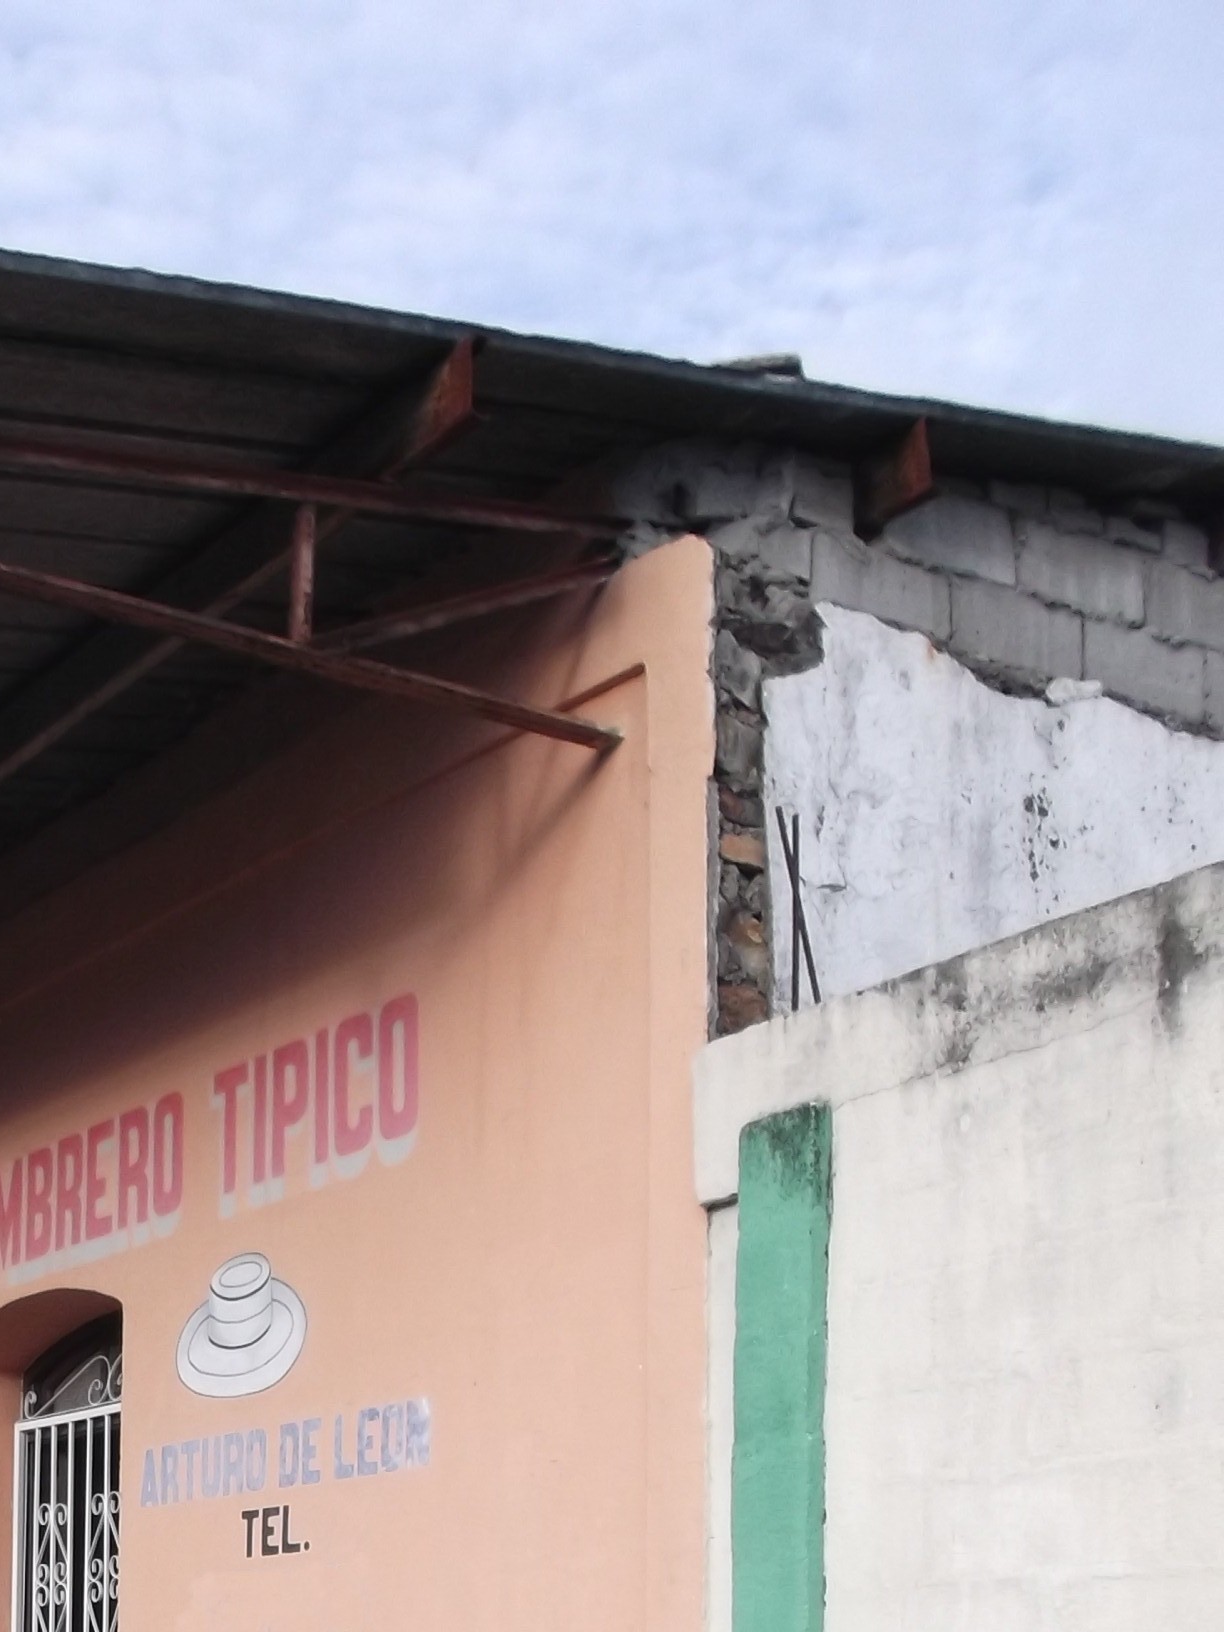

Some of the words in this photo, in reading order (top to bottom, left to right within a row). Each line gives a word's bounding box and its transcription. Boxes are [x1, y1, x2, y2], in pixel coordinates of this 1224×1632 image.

[213, 993, 419, 1196] TIPICO
[140, 1427, 268, 1507] ARTURO
[279, 1417, 322, 1488] DE
[334, 1399, 431, 1480] LEON
[241, 1504, 311, 1558] TEL.
